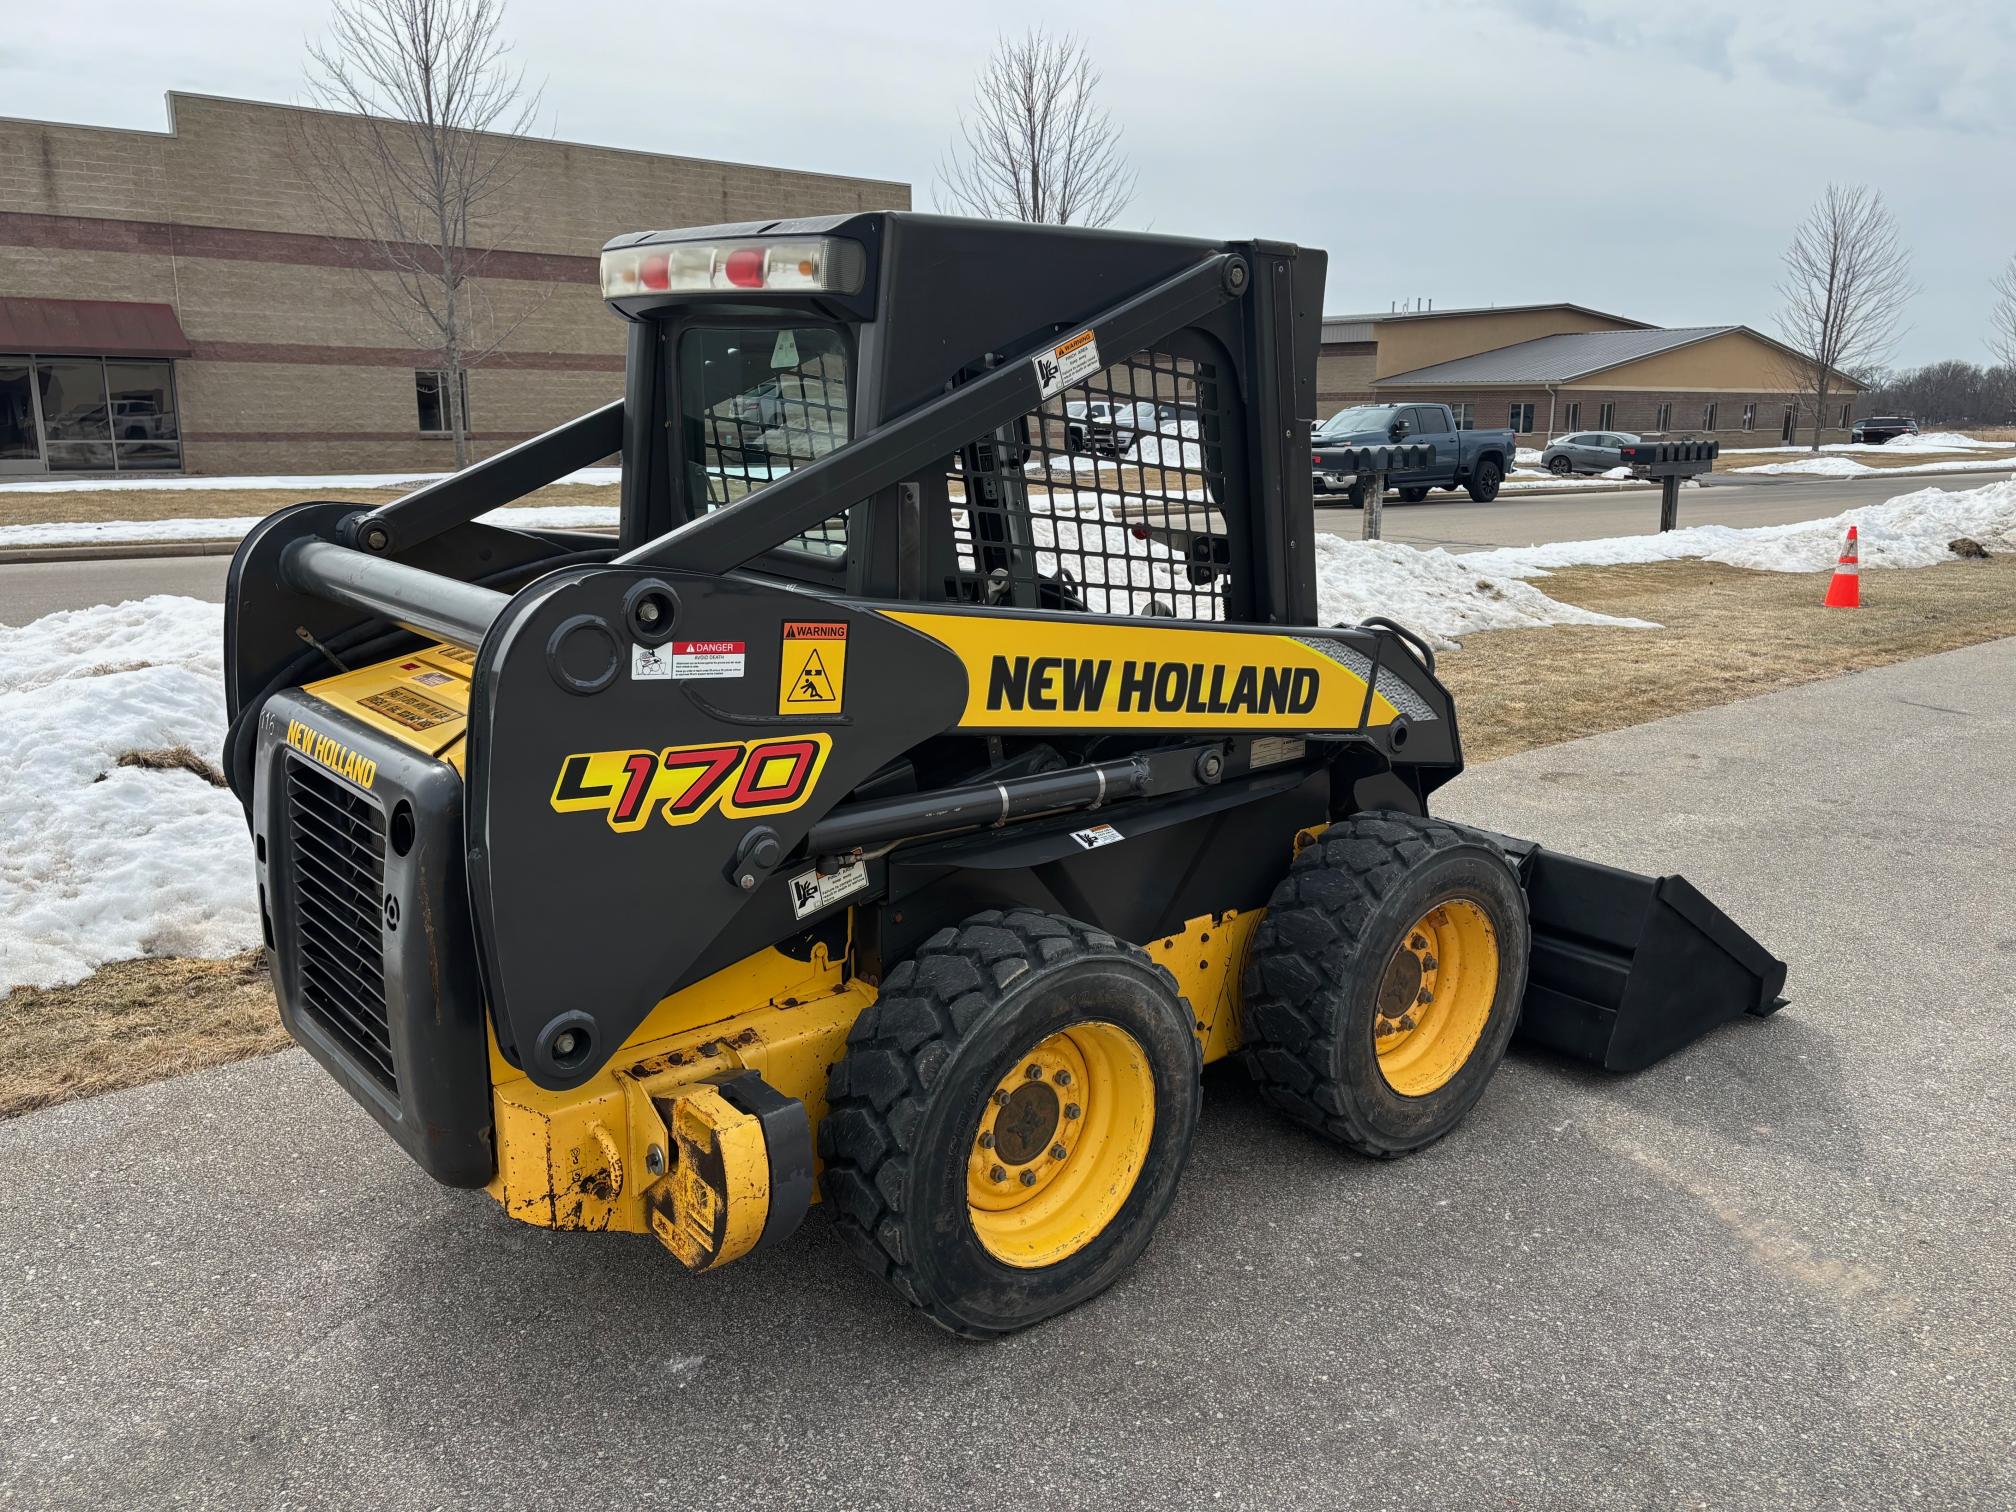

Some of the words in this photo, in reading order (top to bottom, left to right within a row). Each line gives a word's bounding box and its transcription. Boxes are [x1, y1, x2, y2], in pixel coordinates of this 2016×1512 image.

[696, 643, 733, 652] DANGER
[796, 626, 845, 637] WARNING
[986, 655, 1112, 712] NEW
[1116, 660, 1320, 715] HOLLAND
[286, 718, 318, 756] NEW
[313, 733, 377, 790] HOLLAND
[554, 738, 822, 825] L170
